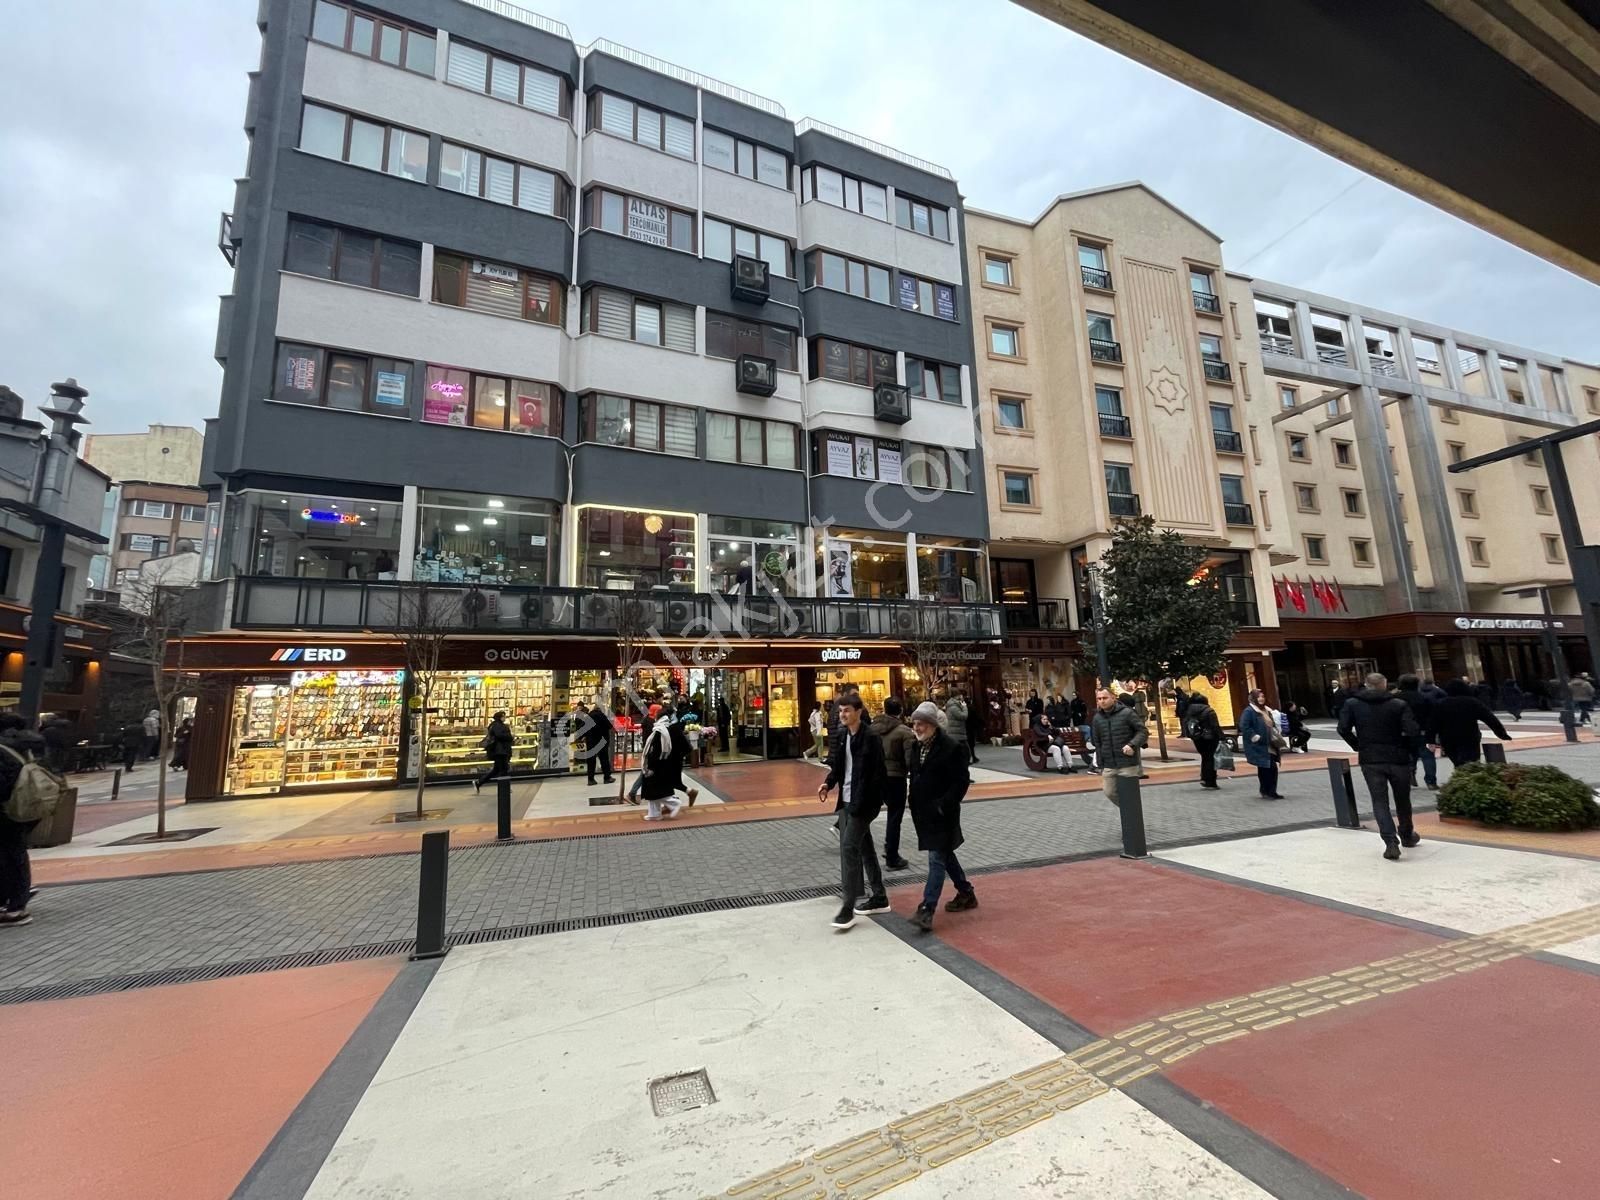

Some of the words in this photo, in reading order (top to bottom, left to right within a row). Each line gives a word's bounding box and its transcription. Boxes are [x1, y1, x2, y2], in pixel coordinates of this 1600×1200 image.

[631, 199, 665, 221] ALTAŞ
[828, 433, 850, 441] AVUKAT
[830, 445, 850, 454] AYVAZ
[303, 648, 346, 662] ERD
[500, 647, 549, 660] GÜNEY
[821, 648, 847, 662] gözüm
